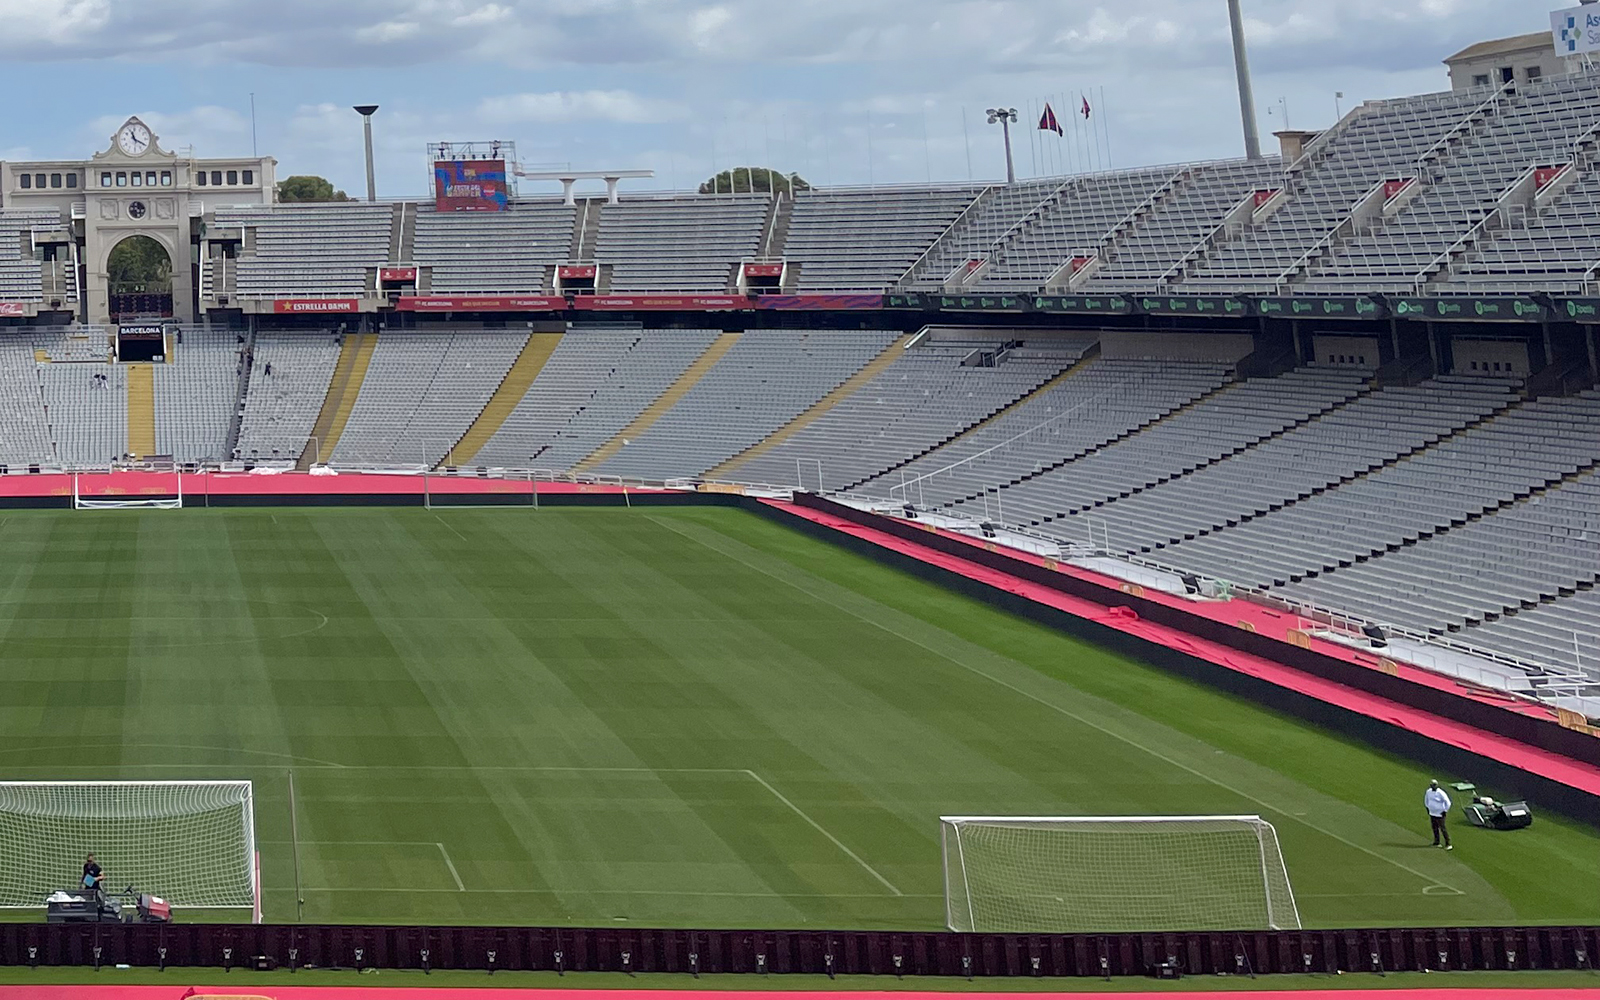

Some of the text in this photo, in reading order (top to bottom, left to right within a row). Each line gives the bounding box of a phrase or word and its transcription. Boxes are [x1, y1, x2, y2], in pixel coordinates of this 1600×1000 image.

[1586, 14, 1600, 28] As
[293, 302, 351, 310] ESTRELLA DAMM
